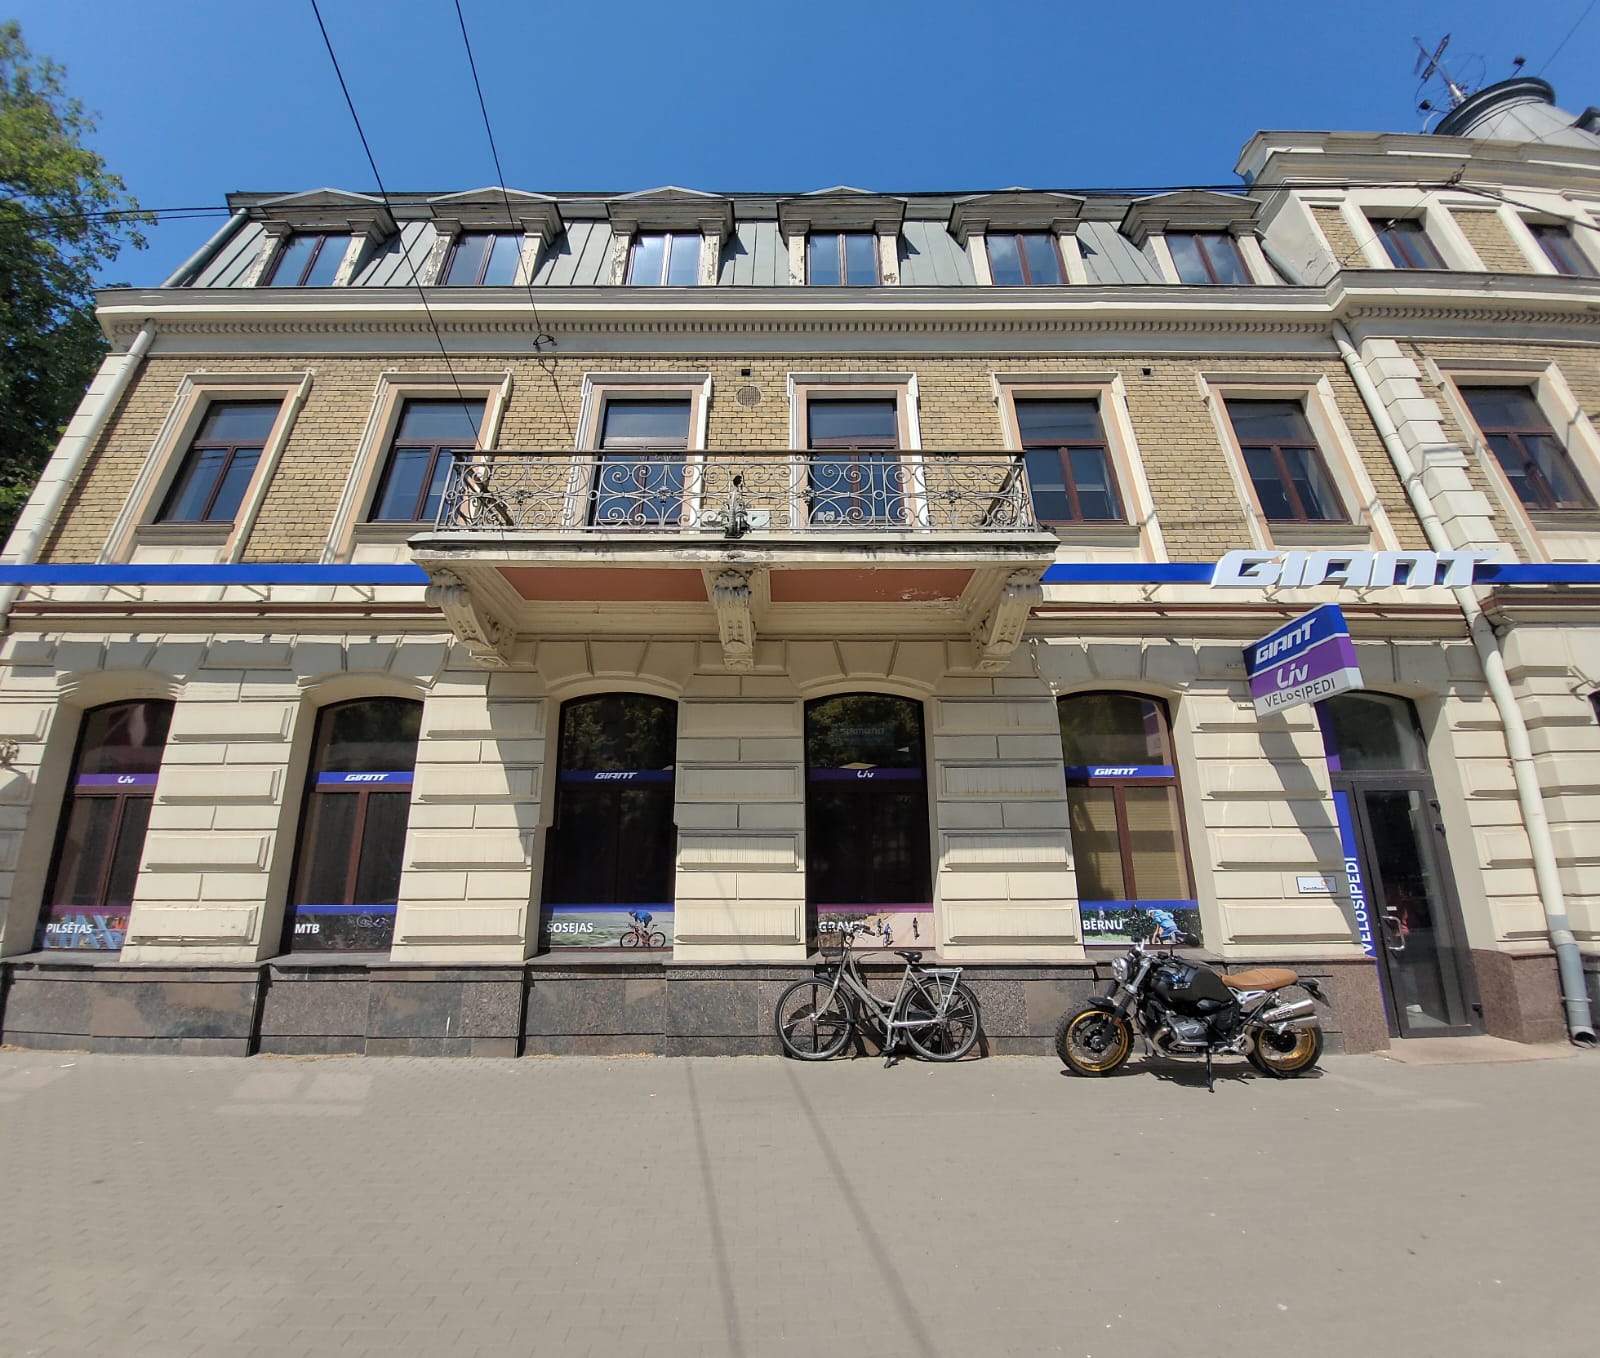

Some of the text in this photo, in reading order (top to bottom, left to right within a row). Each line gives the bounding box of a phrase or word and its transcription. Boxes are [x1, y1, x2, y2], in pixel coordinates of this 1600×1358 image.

[1210, 550, 1497, 589] GIANT
[1255, 618, 1317, 665] GIANT
[1277, 662, 1308, 689] Liv
[118, 775, 135, 783] Liv
[857, 770, 874, 778] Liv
[1344, 857, 1373, 954] VELOSIPEDI
[46, 921, 93, 934] PILSĒTAS
[294, 923, 320, 934] MTB
[1082, 918, 1123, 930] BĒRNU
